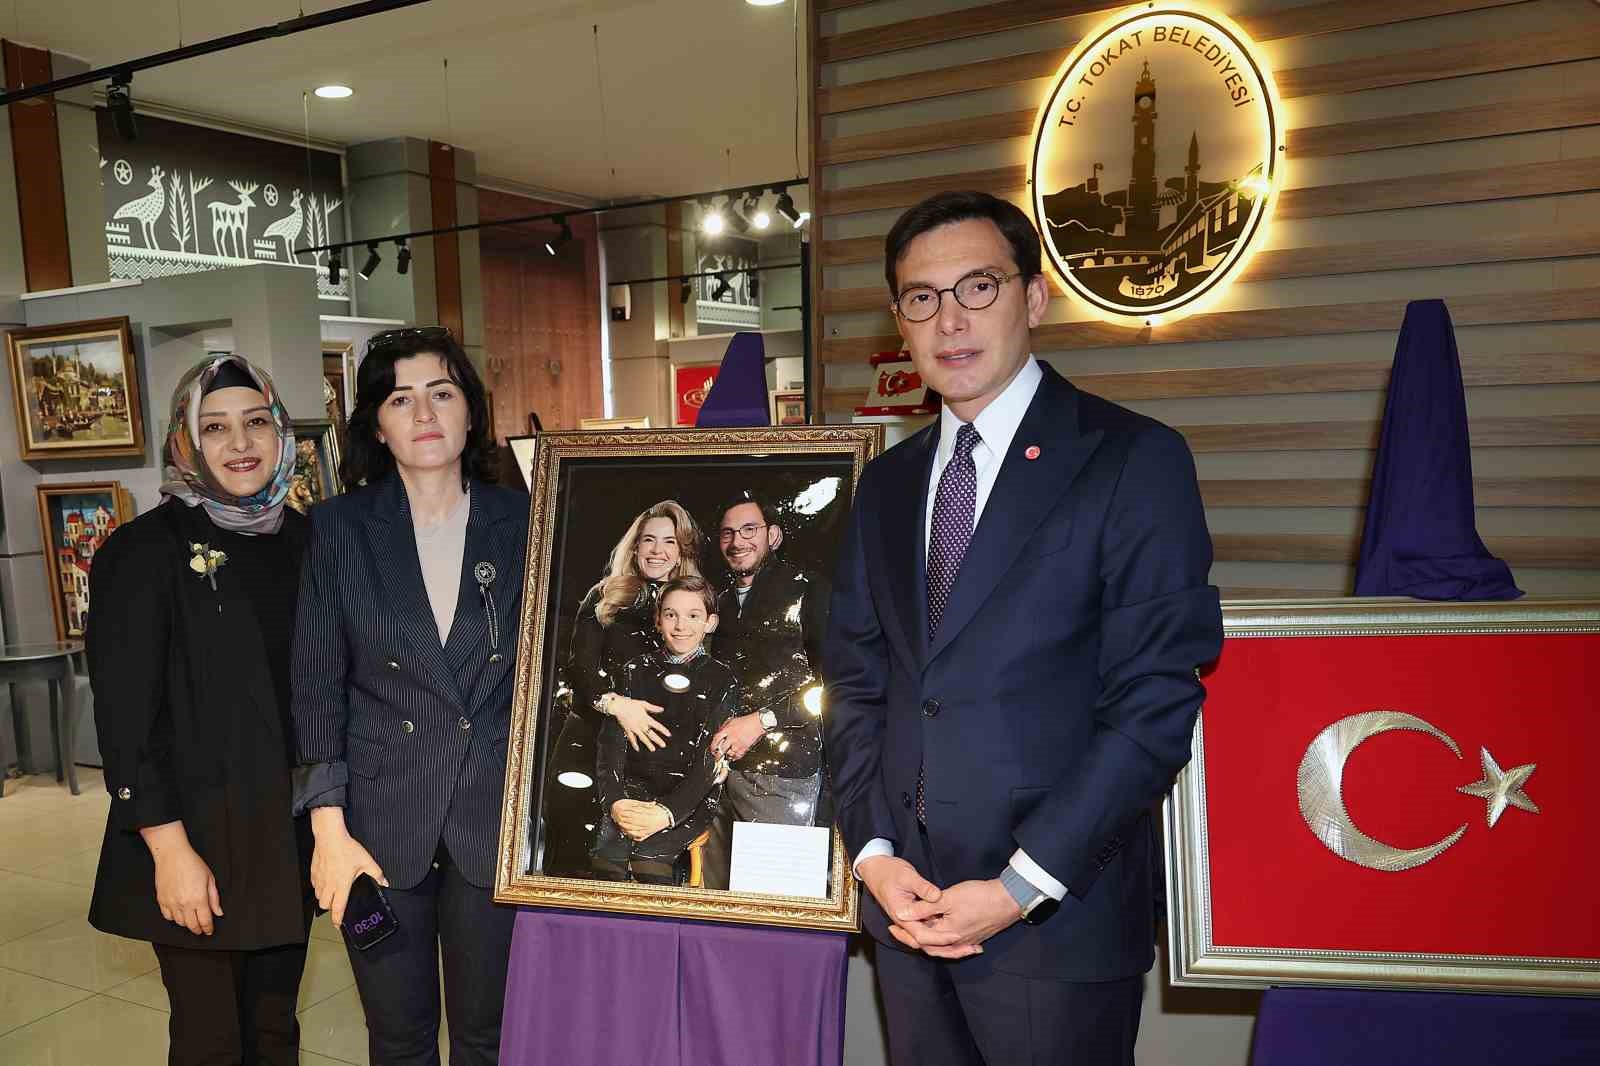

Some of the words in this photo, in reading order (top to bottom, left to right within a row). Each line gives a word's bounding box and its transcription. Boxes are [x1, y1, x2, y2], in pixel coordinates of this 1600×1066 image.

[1058, 94, 1086, 127] T.C.
[1078, 30, 1144, 87] TOKAT
[1153, 26, 1255, 108] BELEDİYESİ
[1130, 285, 1165, 296] 1870
[354, 911, 384, 934] 10:30
